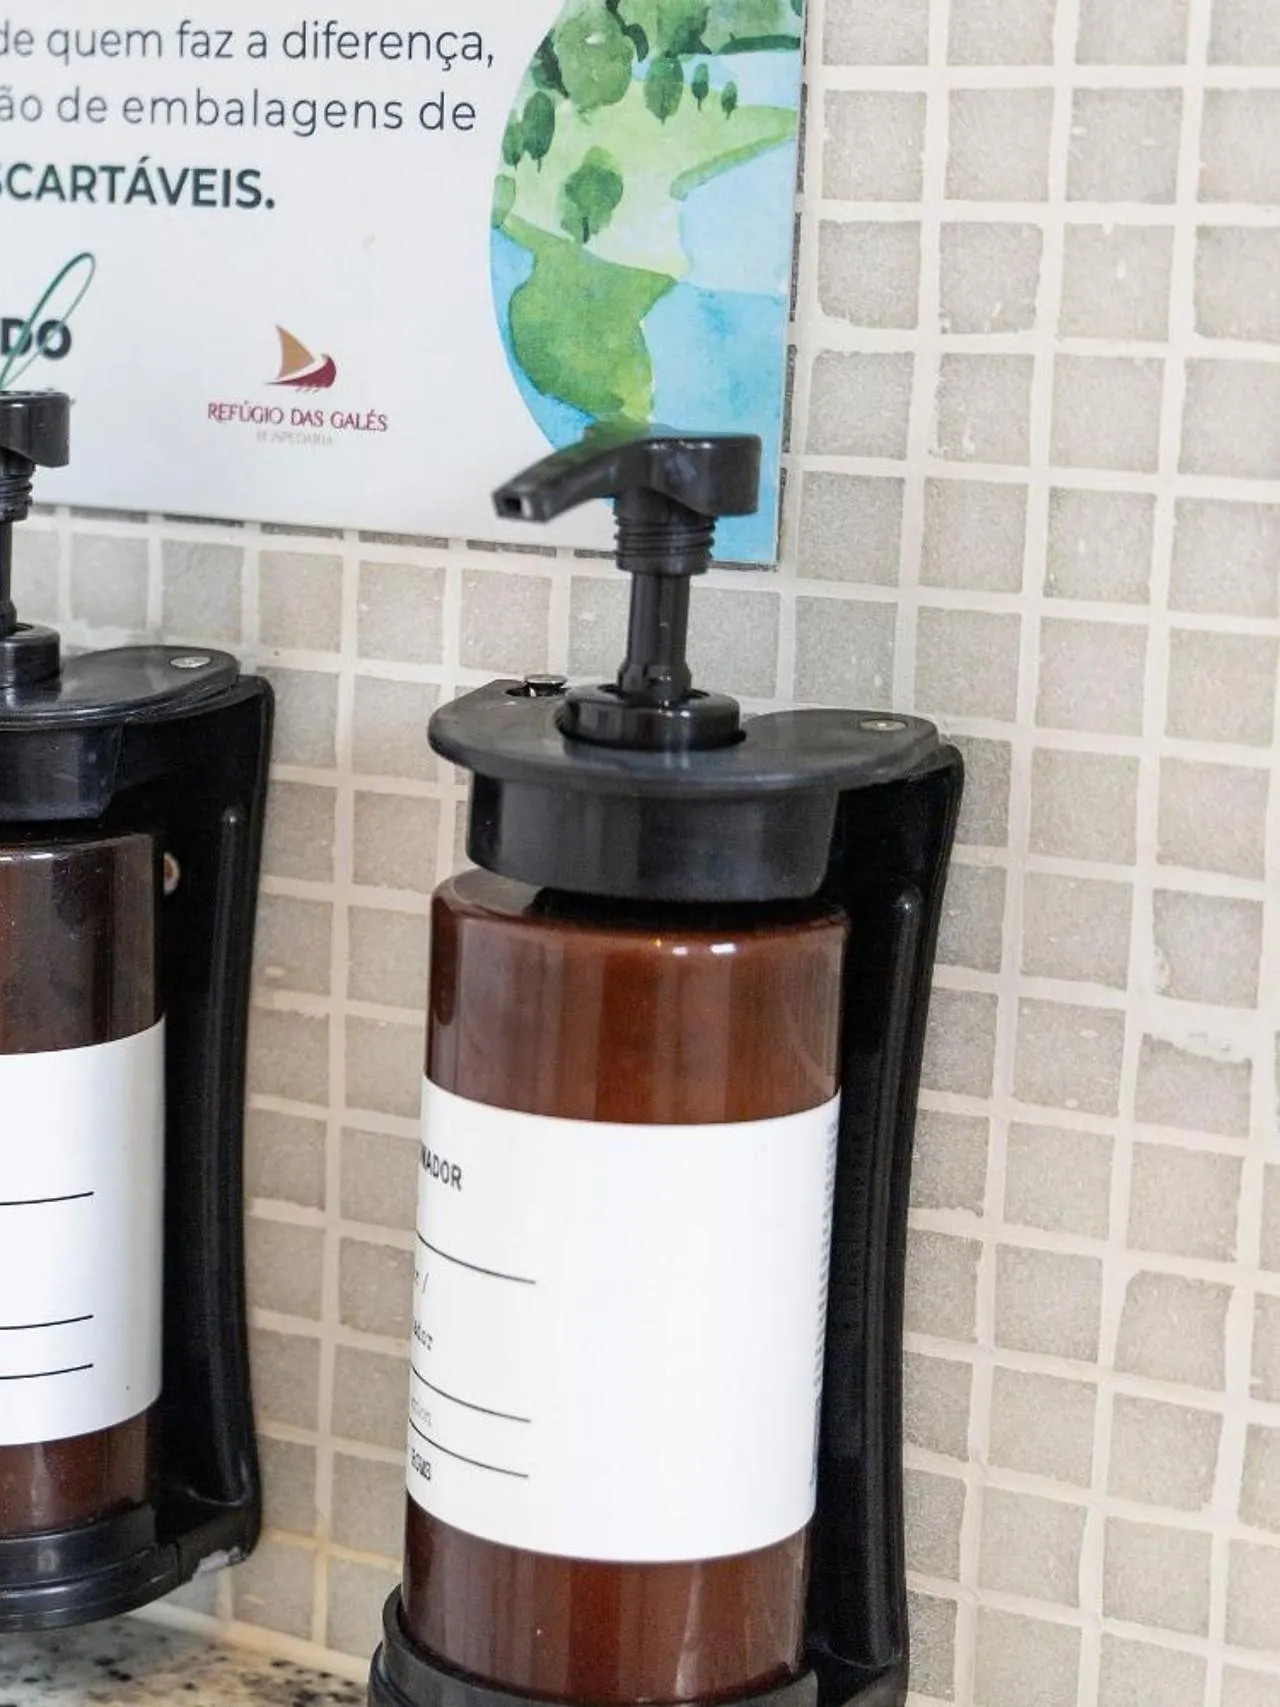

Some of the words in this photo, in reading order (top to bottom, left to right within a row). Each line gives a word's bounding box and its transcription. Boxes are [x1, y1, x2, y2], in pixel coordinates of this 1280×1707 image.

[47, 28, 162, 65] quem
[177, 20, 233, 59] faz
[247, 30, 267, 59] a
[282, 20, 494, 71] diferença,
[58, 86, 107, 124] de
[122, 88, 403, 137] embalagens
[420, 92, 476, 130] de
[207, 400, 284, 425] REFÚGIO
[291, 409, 324, 427] DAS
[330, 409, 388, 432] GALÉS
